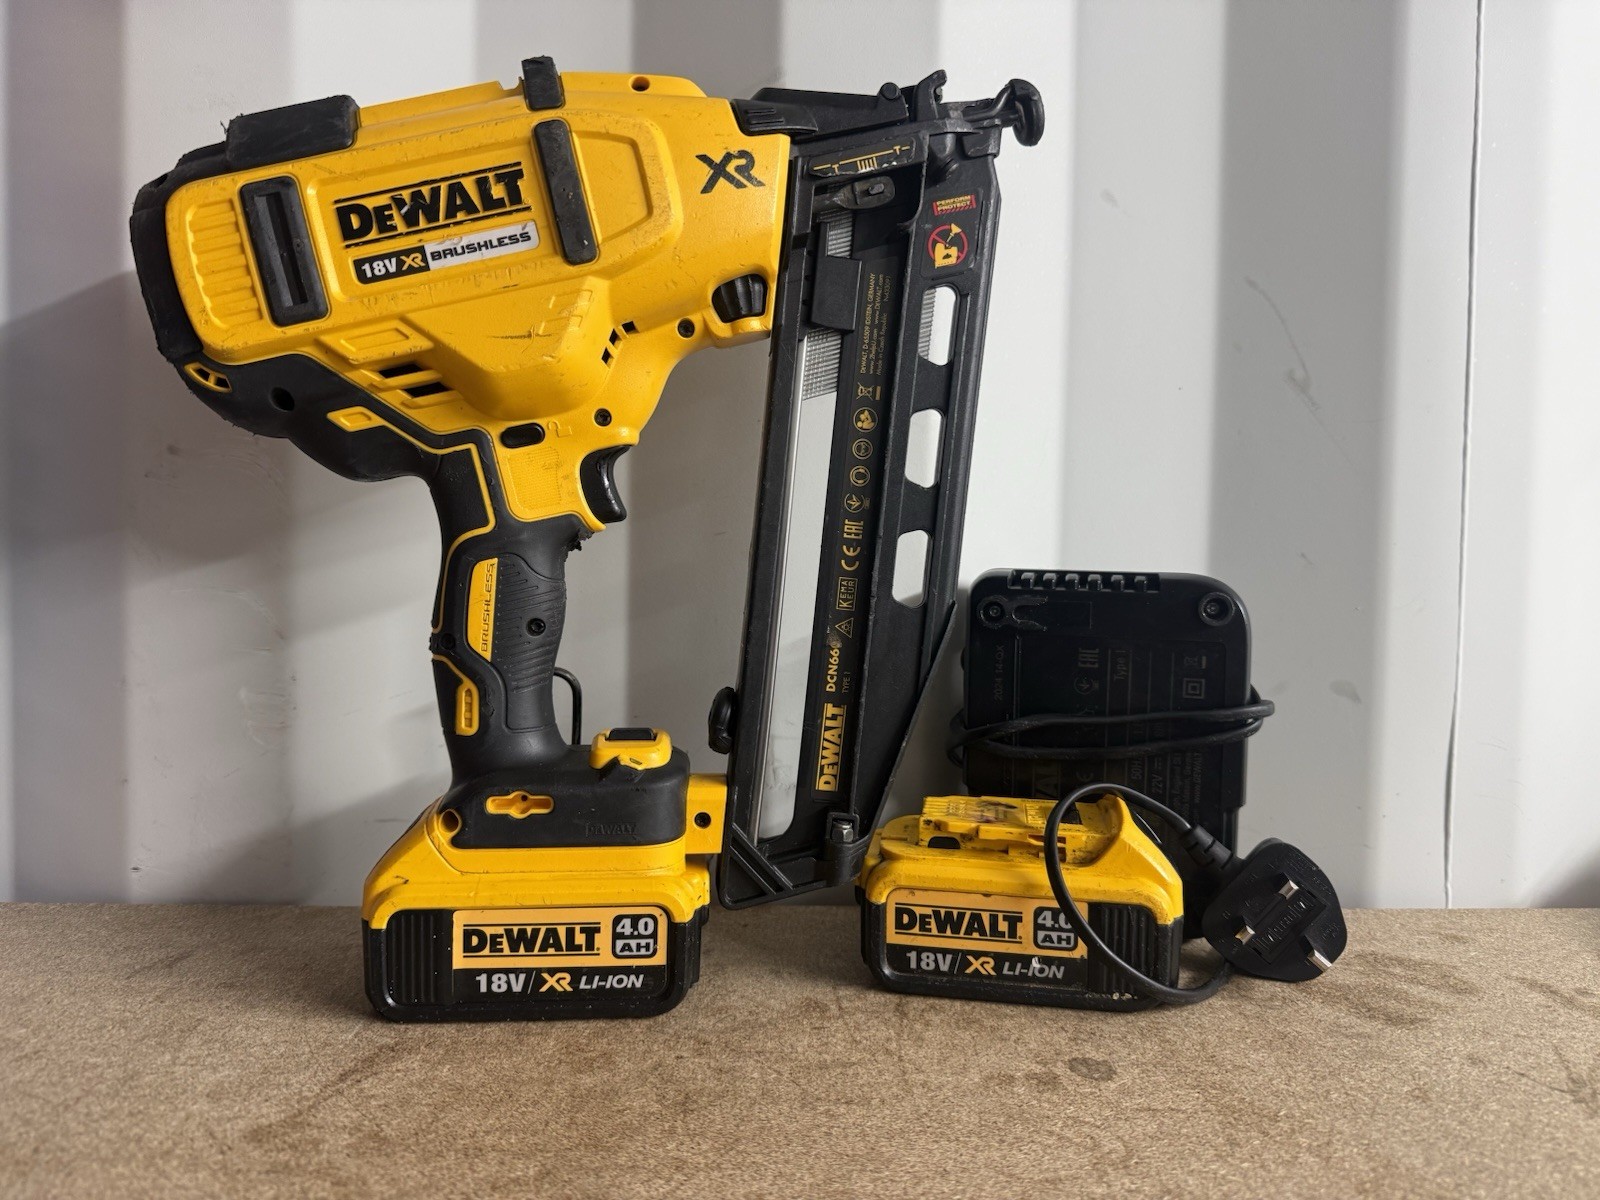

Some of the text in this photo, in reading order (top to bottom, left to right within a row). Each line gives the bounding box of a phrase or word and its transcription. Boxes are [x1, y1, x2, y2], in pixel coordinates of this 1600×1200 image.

[695, 149, 766, 194] XR
[936, 195, 971, 206] PERFORM
[937, 201, 971, 212] PROTECT
[361, 231, 532, 279] 18V XR BRUSHLESS
[867, 272, 876, 302] GERMANY
[844, 518, 864, 540] EAC
[480, 563, 496, 653] BRUSHLESS
[1113, 655, 1129, 682] Type
[842, 677, 851, 694] TYPE
[616, 917, 655, 936] 4.0
[618, 941, 653, 954] AH
[1040, 933, 1072, 947] AH
[965, 954, 998, 976] XR
[1002, 962, 1064, 979] LI-ION
[538, 973, 573, 992] XR
[580, 973, 644, 989] LI-ION
